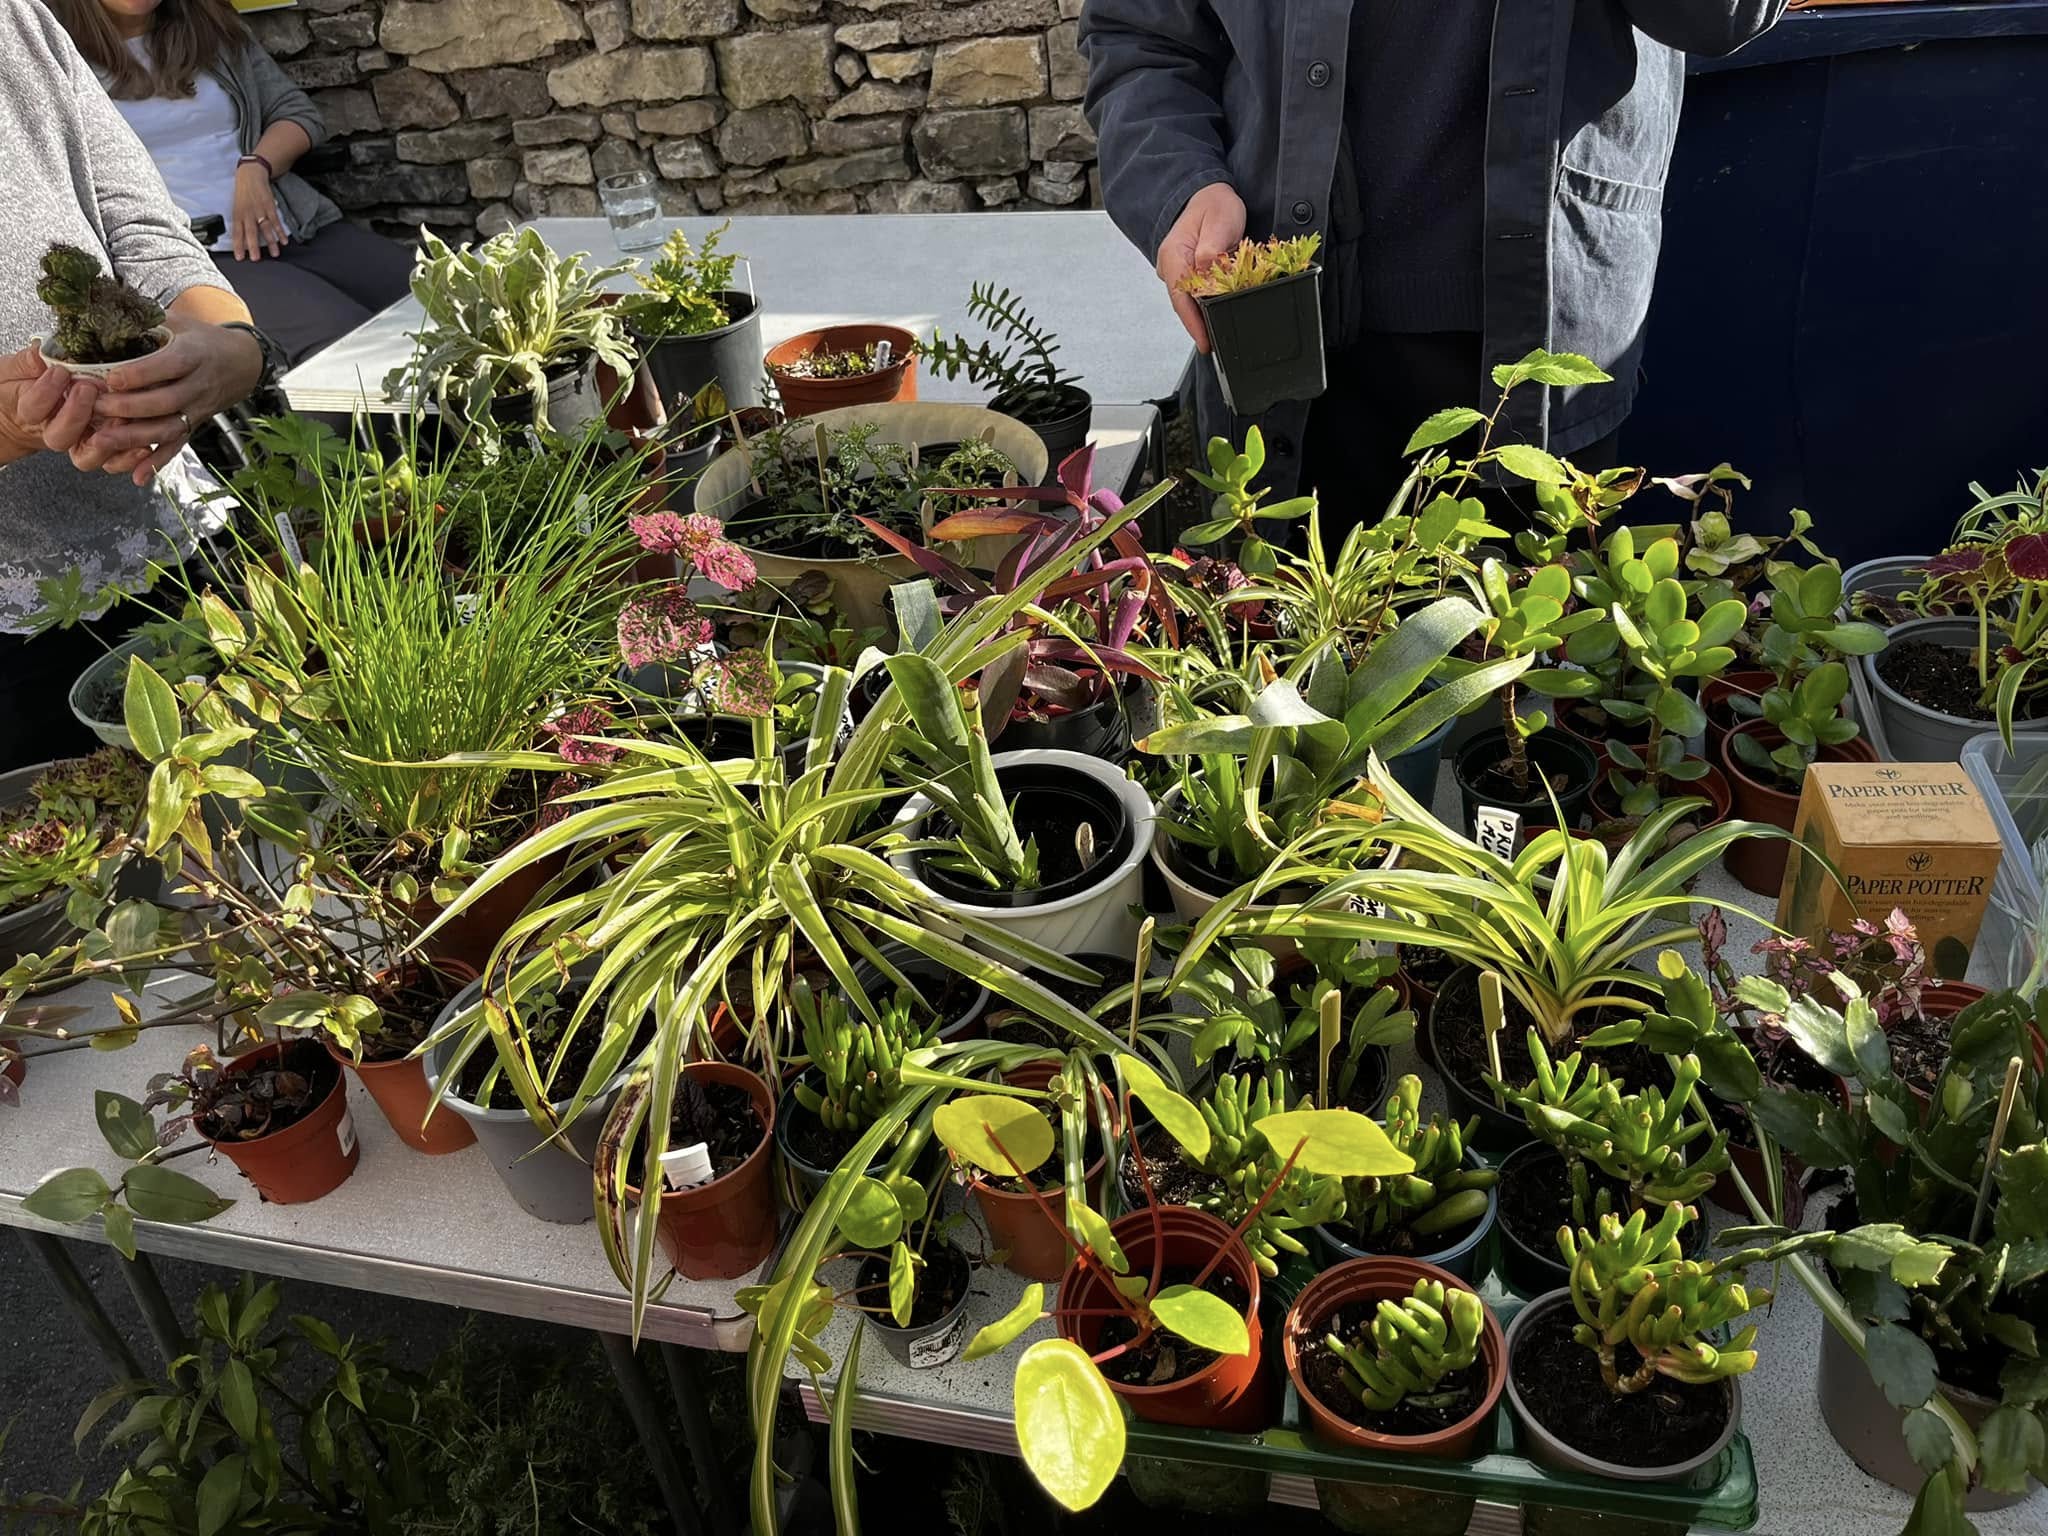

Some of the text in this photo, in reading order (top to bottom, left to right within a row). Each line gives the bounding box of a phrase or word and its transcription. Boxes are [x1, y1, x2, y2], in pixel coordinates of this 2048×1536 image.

[1828, 782, 1968, 798] PAPER POTTER
[1847, 875, 1984, 896] PAPER POTTER
